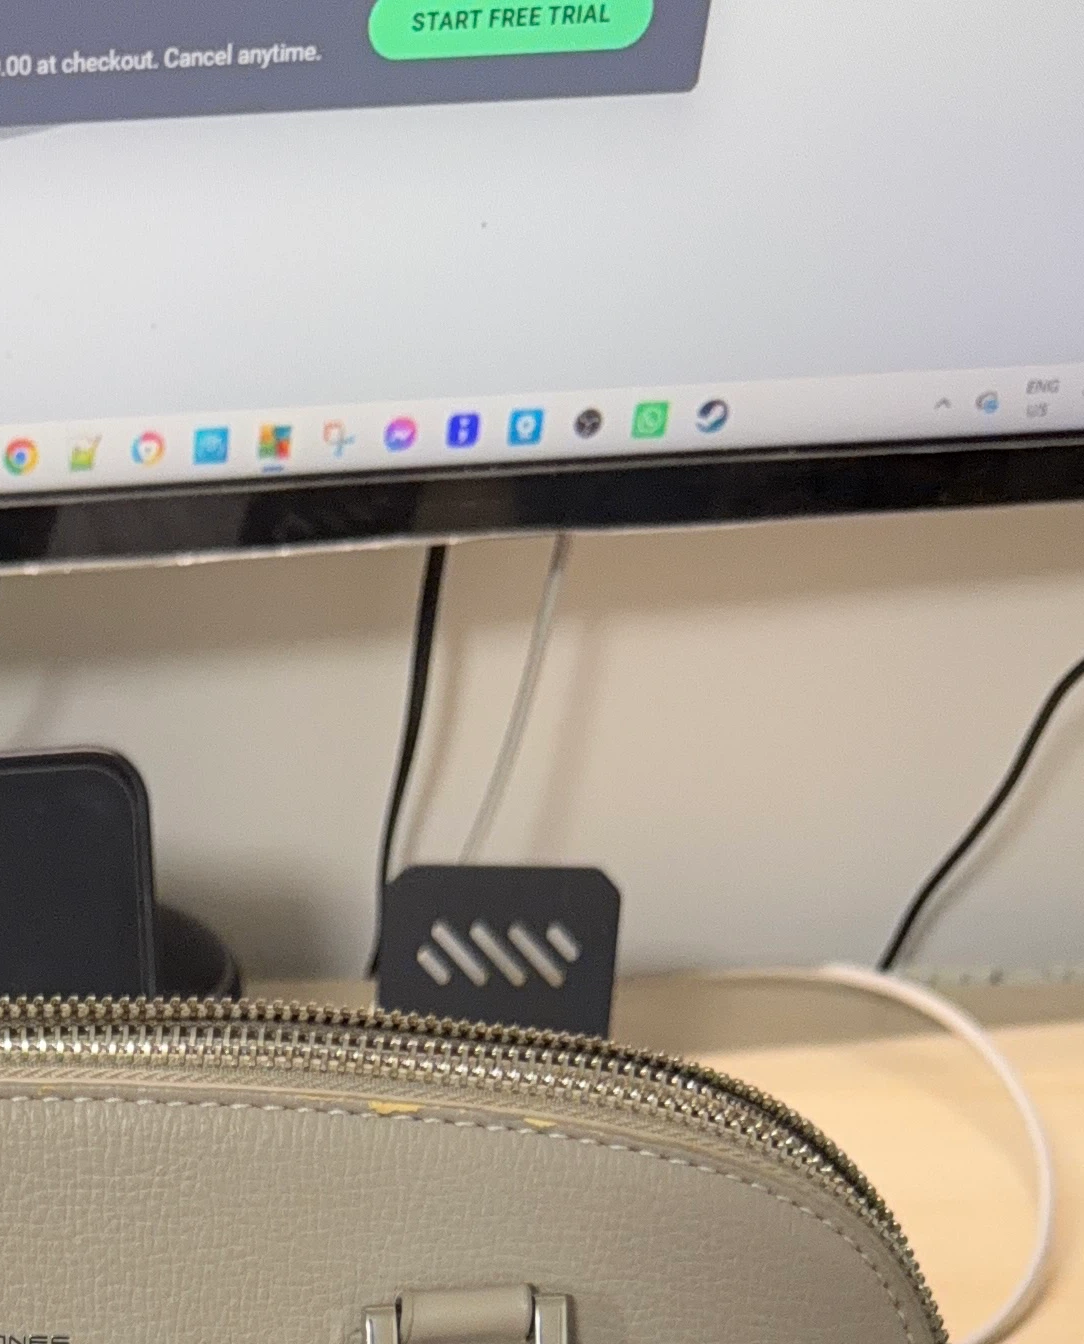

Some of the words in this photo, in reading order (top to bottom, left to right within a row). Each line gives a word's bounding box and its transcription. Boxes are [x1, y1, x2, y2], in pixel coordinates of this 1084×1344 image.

[411, 9, 484, 33] START
[488, 6, 541, 29] FREE
[548, 3, 611, 25] TRIAL
[36, 52, 58, 75] at
[61, 49, 159, 74] checkout.
[164, 43, 233, 69] Cancel
[237, 43, 322, 70] anytime.
[1025, 379, 1061, 395] ENG
